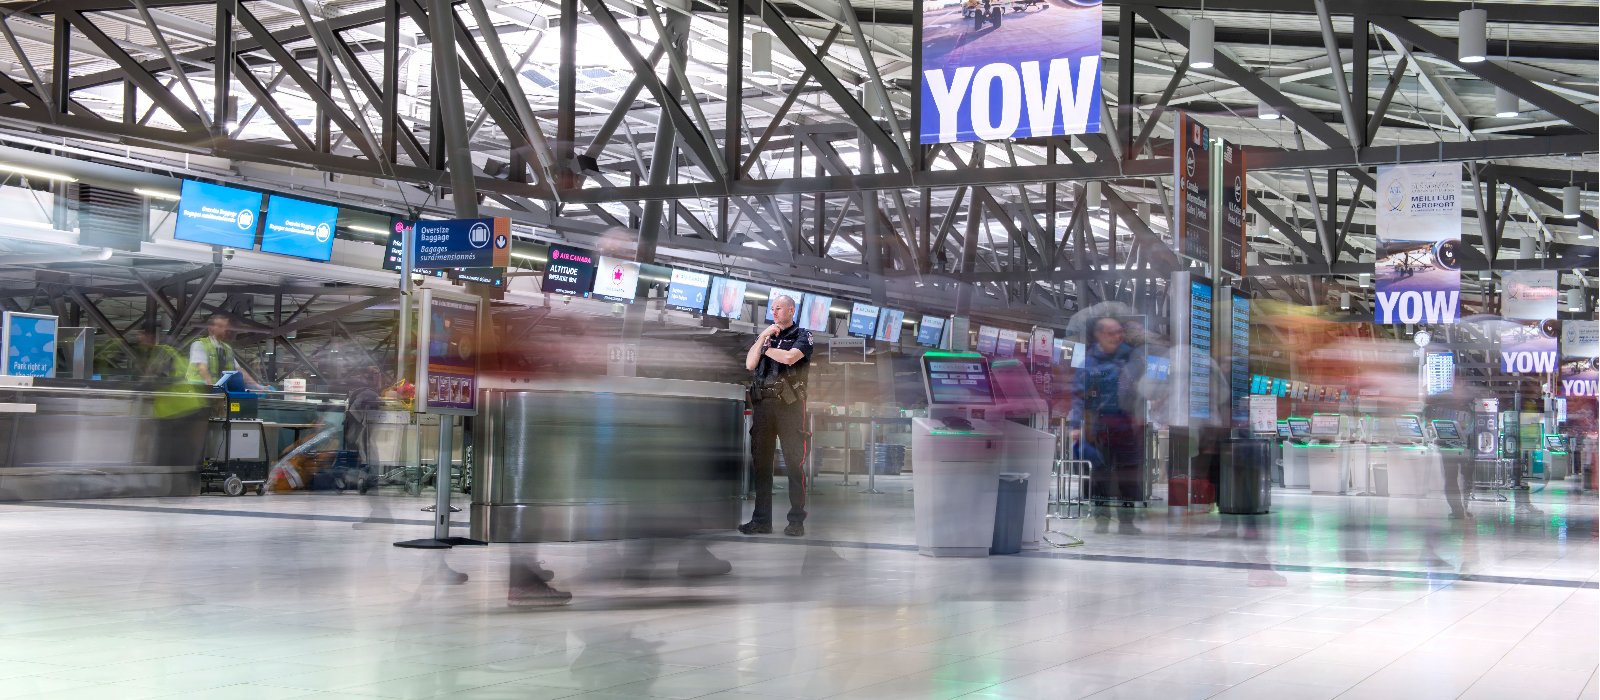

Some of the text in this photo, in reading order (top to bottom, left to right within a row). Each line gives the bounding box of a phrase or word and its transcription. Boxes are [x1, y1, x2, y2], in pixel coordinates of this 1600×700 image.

[924, 55, 1099, 143] YOW
[1411, 194, 1455, 202] MEILLEUR
[421, 226, 450, 234] Oversize
[421, 234, 450, 243] Baggage
[420, 245, 448, 255] Bagages
[420, 252, 476, 262] surdimensionnés
[559, 252, 592, 264] AIR CANADA
[550, 264, 578, 276] ALTITUDE
[1376, 290, 1459, 325] YOW
[13, 361, 27, 370] Park
[27, 362, 40, 373] right
[1502, 351, 1556, 373] YOW
[1562, 379, 1600, 397] YOW
